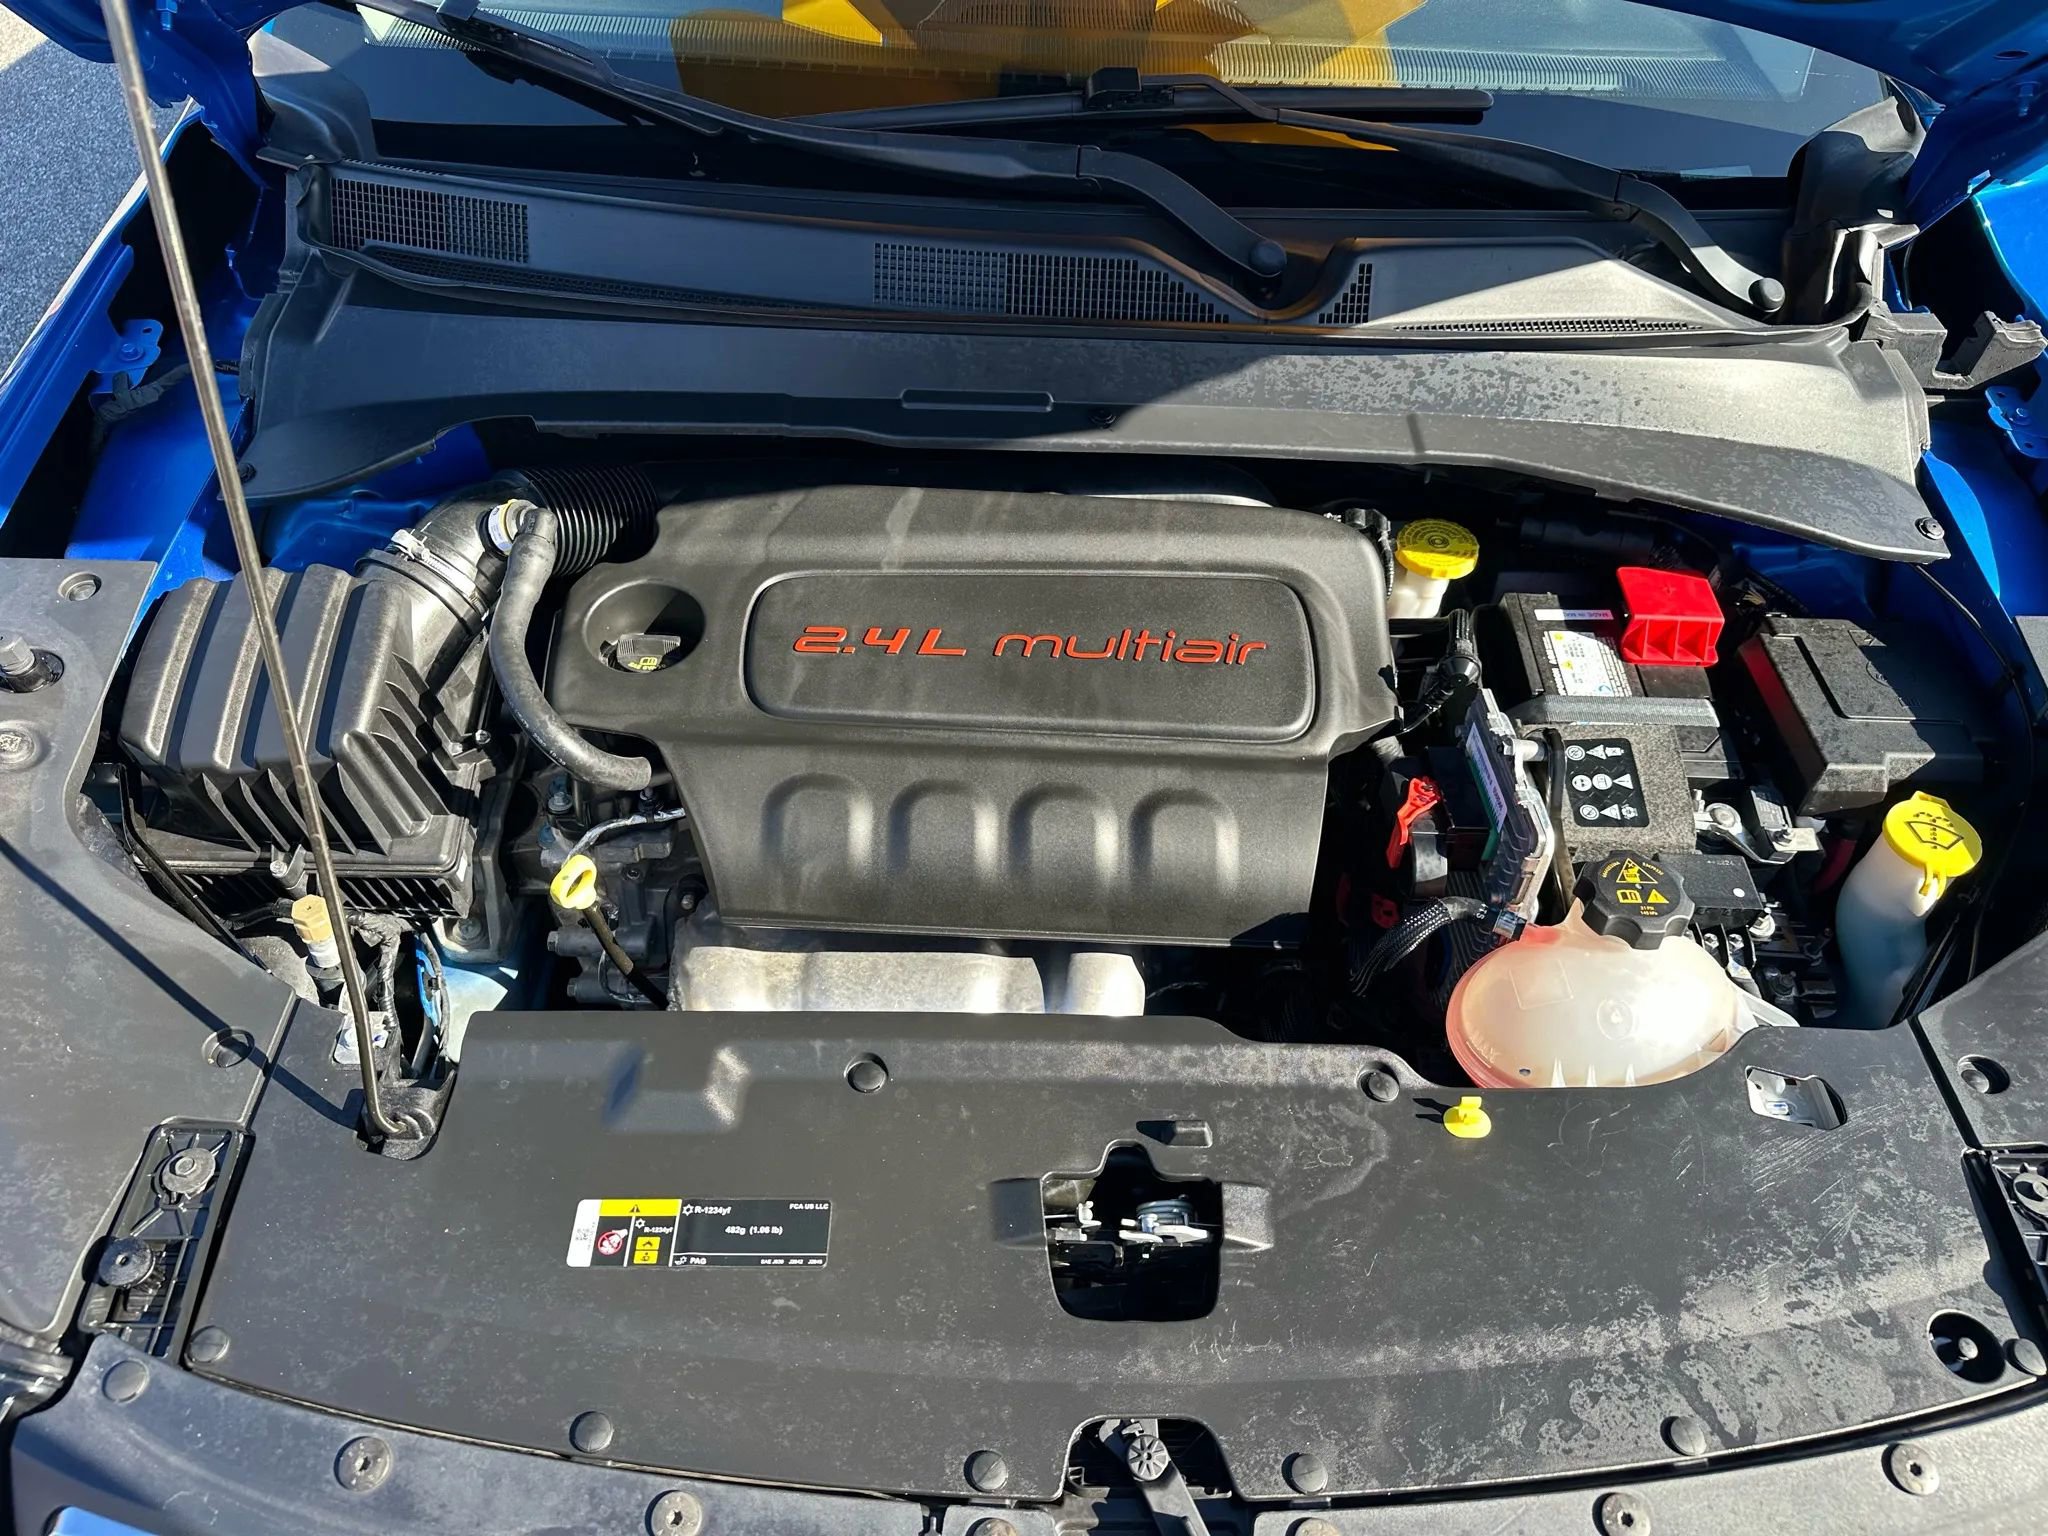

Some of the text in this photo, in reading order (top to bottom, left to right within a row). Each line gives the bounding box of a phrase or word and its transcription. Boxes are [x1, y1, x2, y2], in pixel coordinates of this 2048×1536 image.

[993, 628, 1268, 667] multiair
[694, 1205, 732, 1216] R-1234yf
[724, 1225, 747, 1236] 482g
[689, 1256, 707, 1265] PAG
